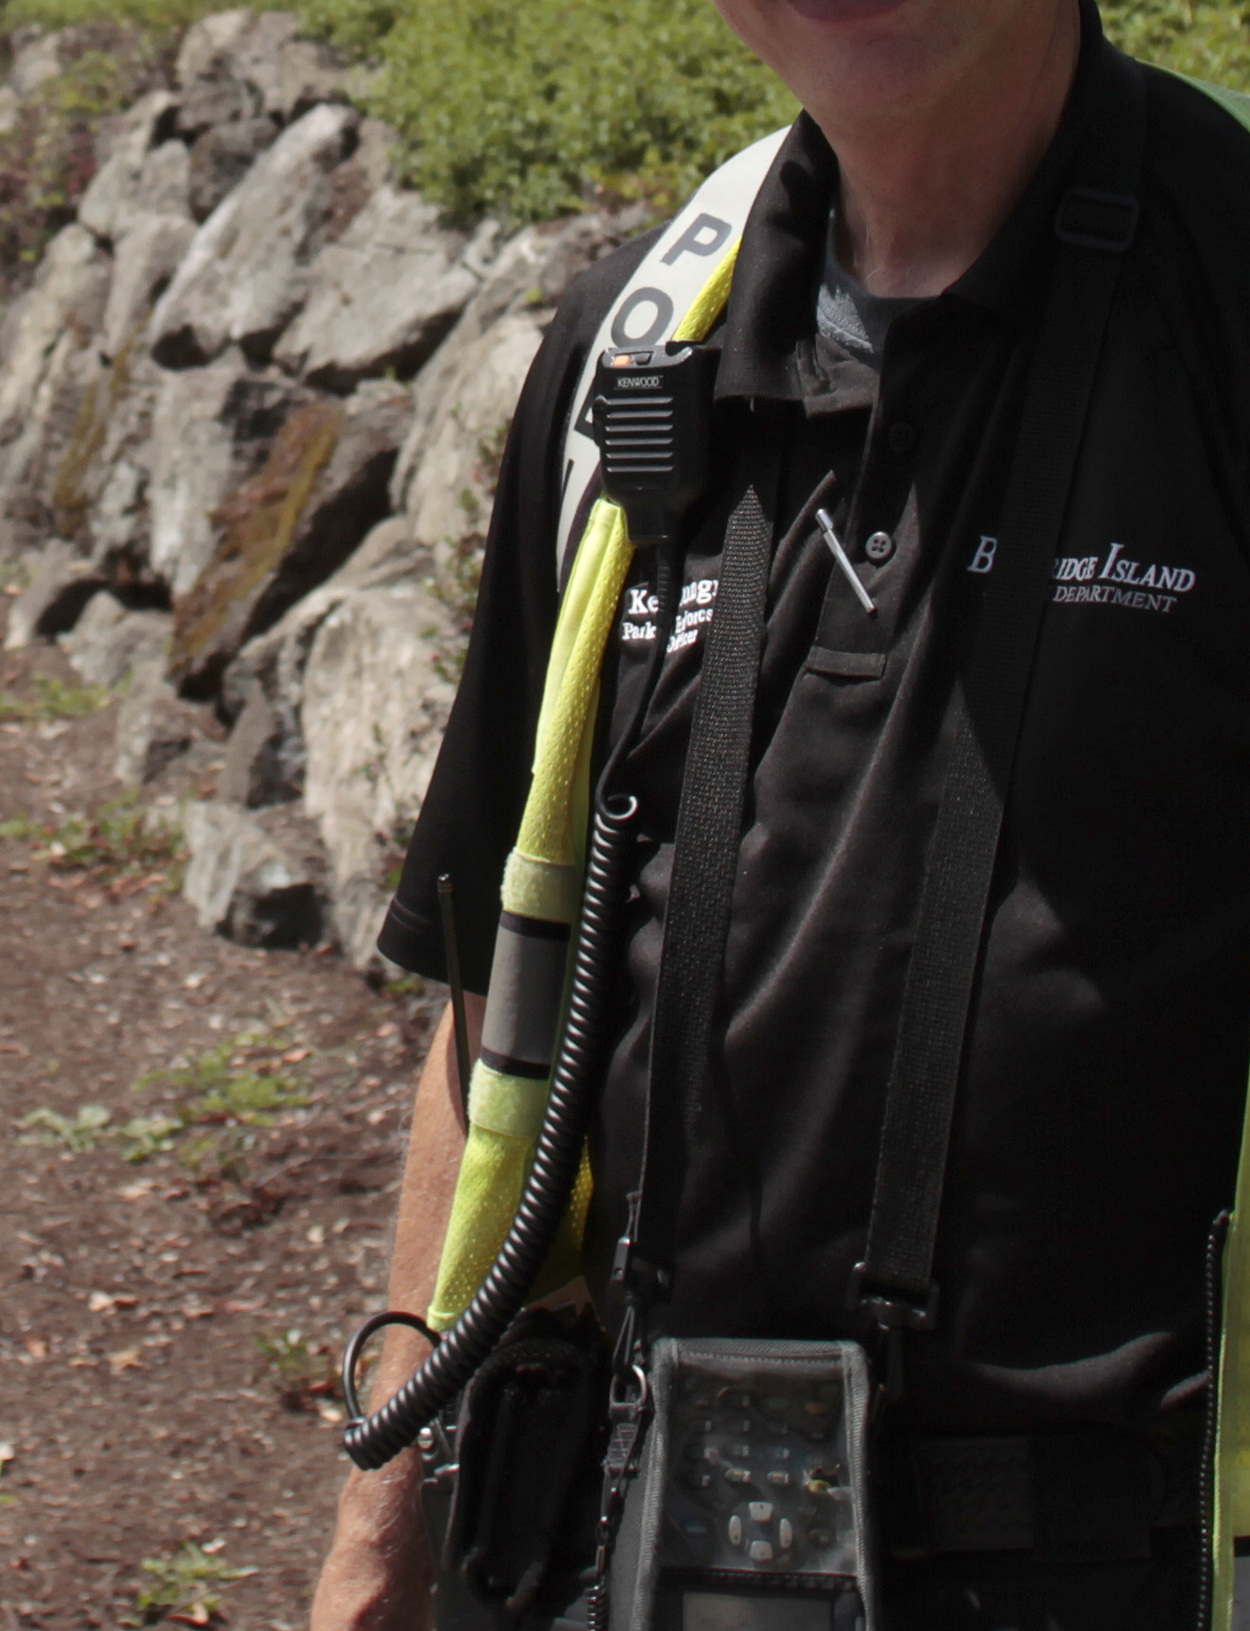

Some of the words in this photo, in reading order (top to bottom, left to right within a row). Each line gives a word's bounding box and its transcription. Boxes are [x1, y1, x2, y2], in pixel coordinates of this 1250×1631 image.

[617, 376, 660, 389] KENWOOD
[1099, 541, 1197, 593] ISLAND
[1052, 583, 1178, 614] DEPARTMENT
